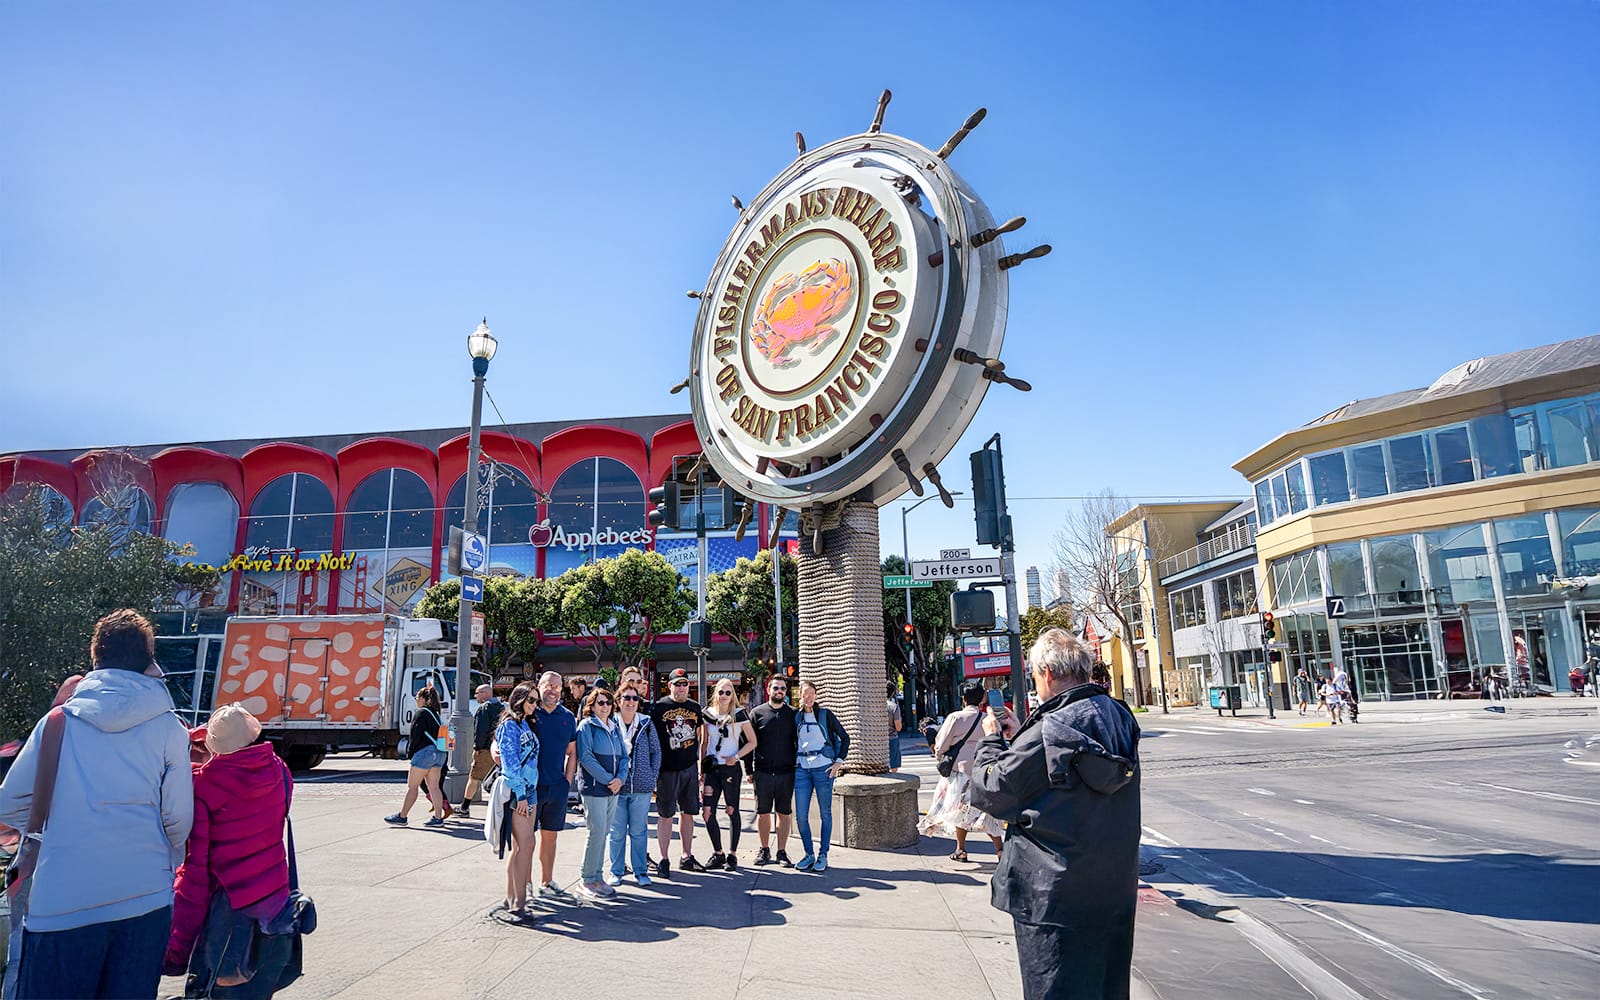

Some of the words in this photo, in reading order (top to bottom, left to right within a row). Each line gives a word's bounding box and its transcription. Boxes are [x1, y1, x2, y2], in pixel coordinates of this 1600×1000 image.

[832, 186, 902, 272] WHARF
[715, 364, 743, 402] OF
[731, 394, 775, 442] SAN
[775, 288, 900, 442] FRANCISCO
[550, 525, 653, 551] Applebee's
[276, 554, 292, 572] It
[295, 558, 314, 572] or
[316, 551, 357, 572] Not!
[943, 550, 960, 559] 200
[921, 564, 993, 576] Jefferson
[389, 581, 417, 596] XING
